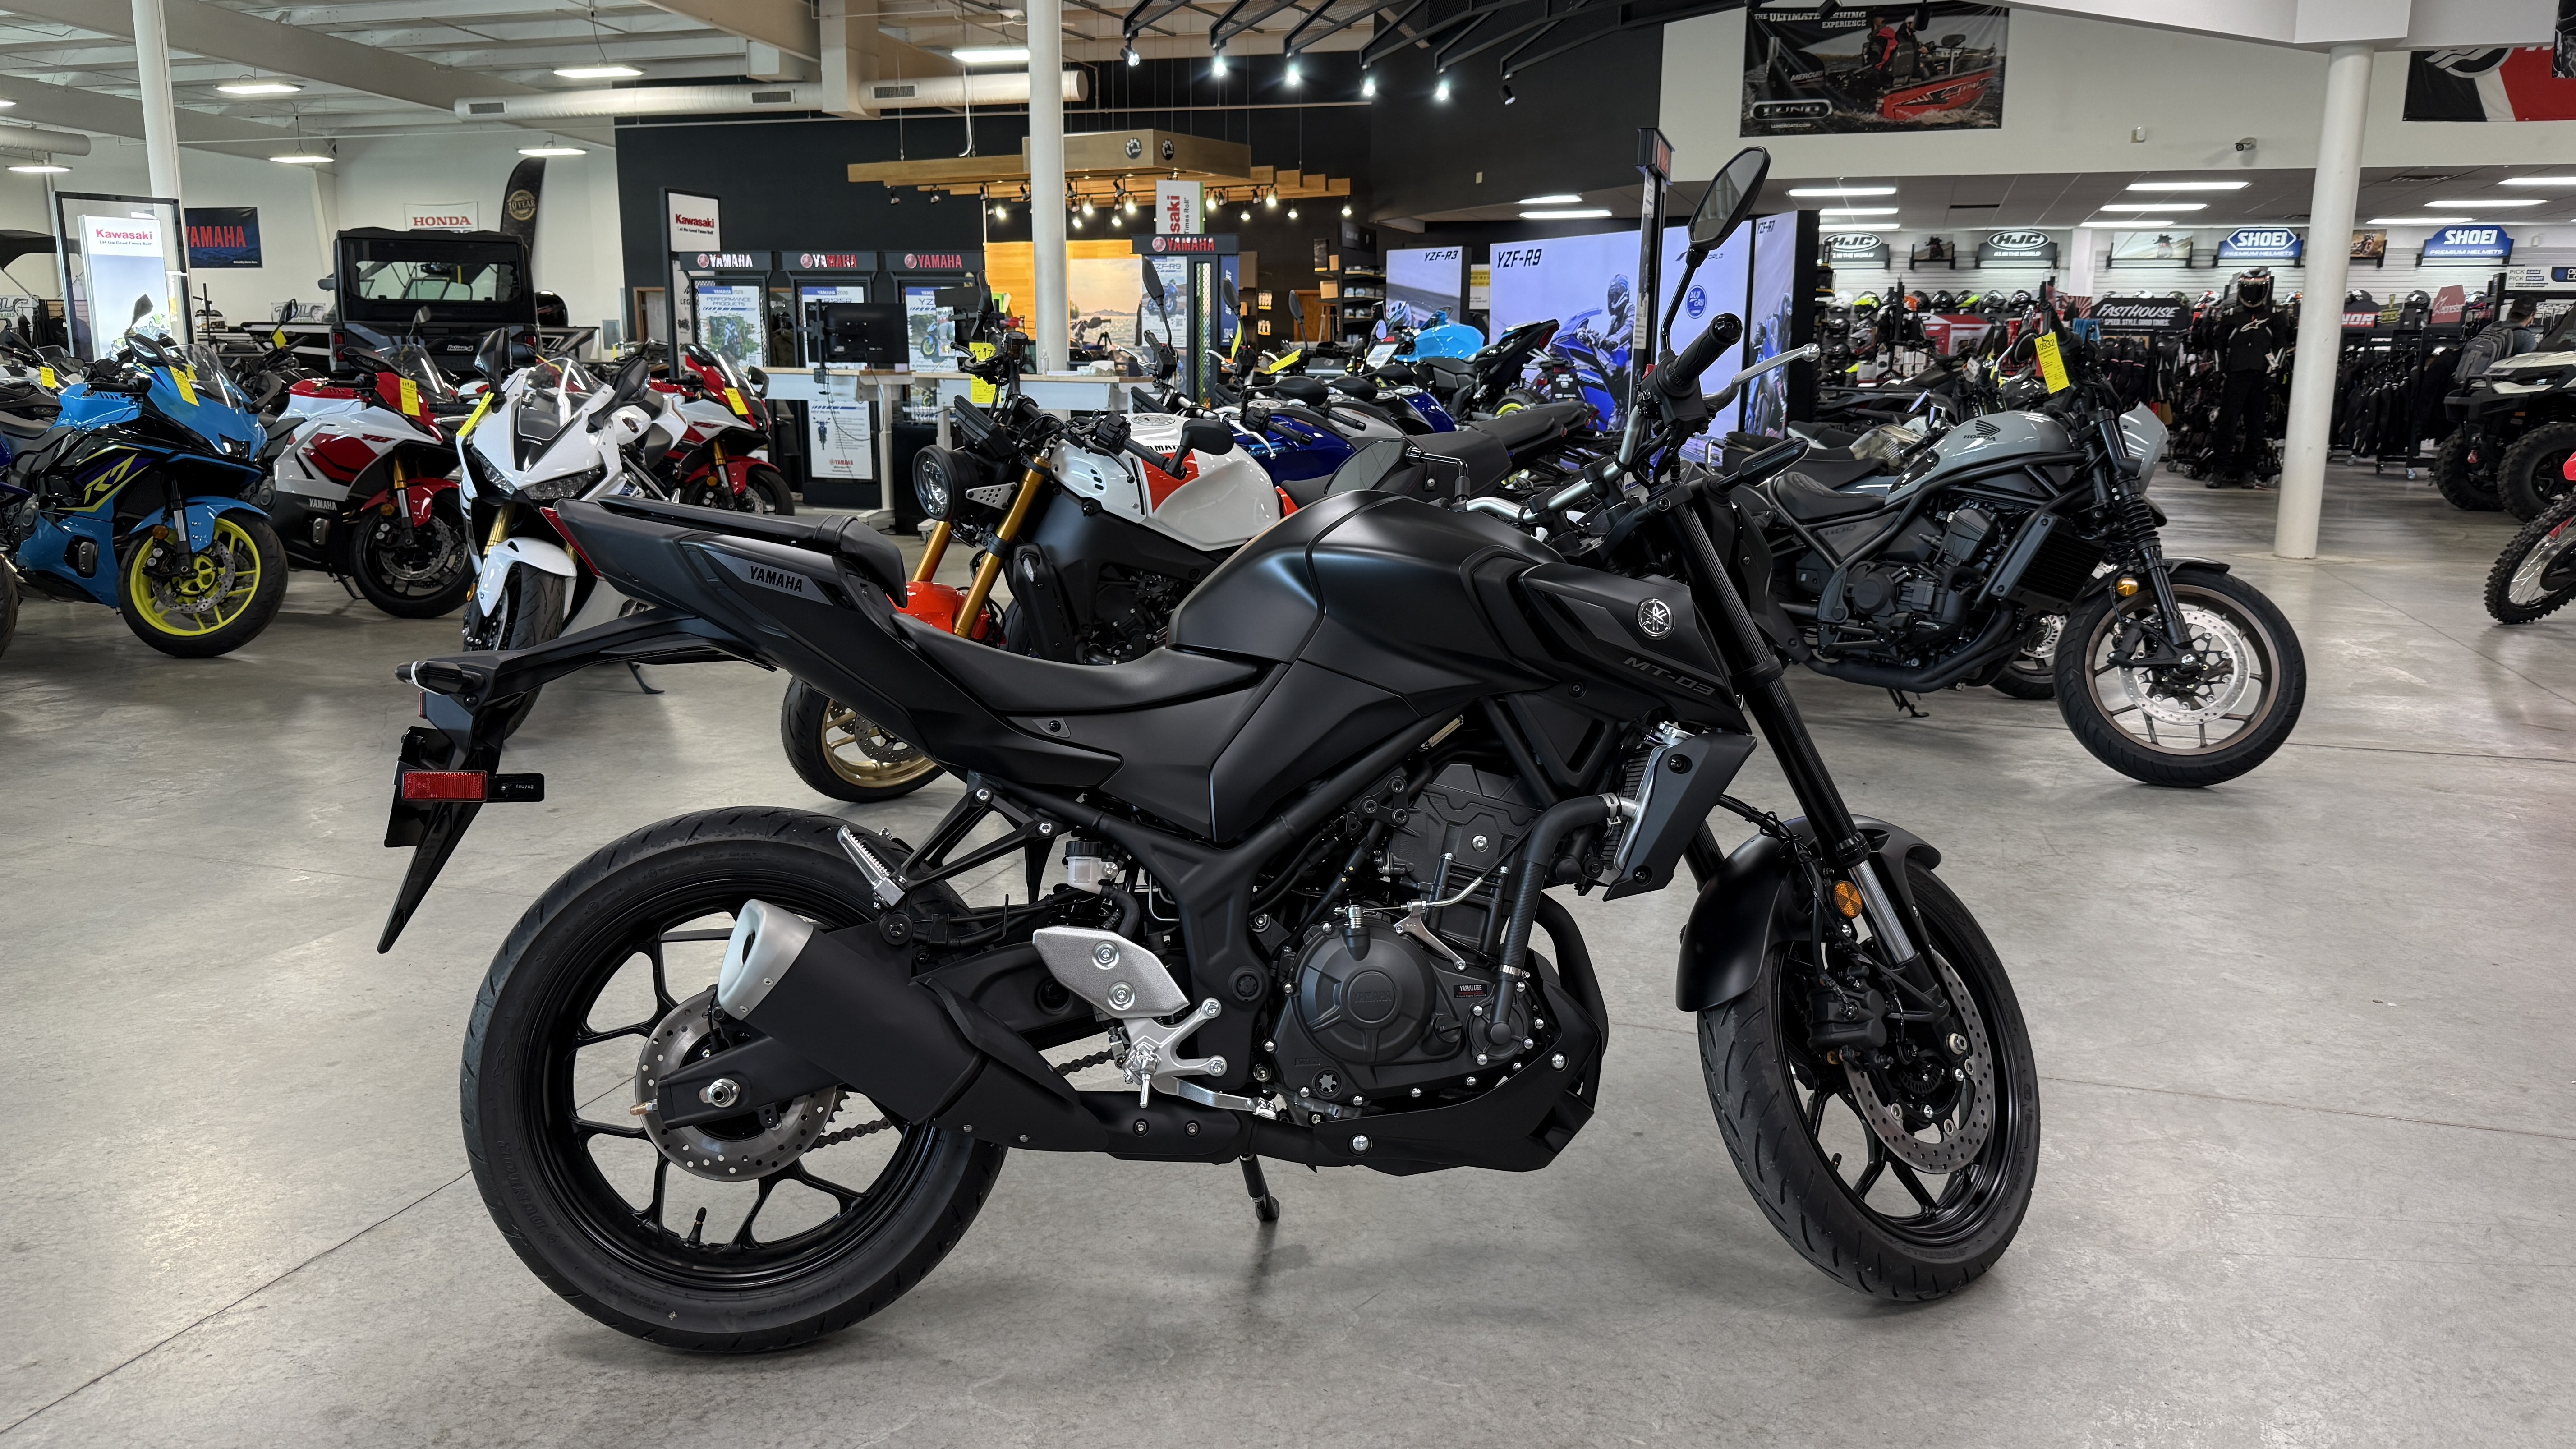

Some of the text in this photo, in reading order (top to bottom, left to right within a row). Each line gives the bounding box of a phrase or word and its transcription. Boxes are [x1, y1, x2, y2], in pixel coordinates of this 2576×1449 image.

[1822, 20, 1866, 28] EXPERIENCE
[413, 216, 471, 226] HONDA
[675, 214, 714, 228] Kawasaki
[1167, 196, 1180, 234] saki
[96, 229, 152, 240] Kawasaki
[1996, 235, 2041, 244] HJC
[2237, 232, 2287, 246] SHOEI
[2443, 230, 2498, 245] SHOEI
[1167, 238, 1215, 251] YAMAHA
[1833, 237, 1873, 246] HJC
[709, 254, 753, 267] YAMAHA
[813, 254, 858, 268] YAMAHA
[917, 254, 962, 268] YAMAHA
[1424, 250, 1458, 262] YZF-R3
[1497, 248, 1542, 268] YZF-R9
[2096, 304, 2180, 318] FASTHOUSE
[2037, 339, 2056, 352] 10932
[83, 453, 138, 505] R7
[309, 498, 338, 511] YAMAHA
[1824, 524, 1857, 536] 1100
[750, 565, 803, 593] YAMAHA
[1623, 657, 1716, 696] MT-03
[1353, 991, 1392, 1003] YAMAHA
